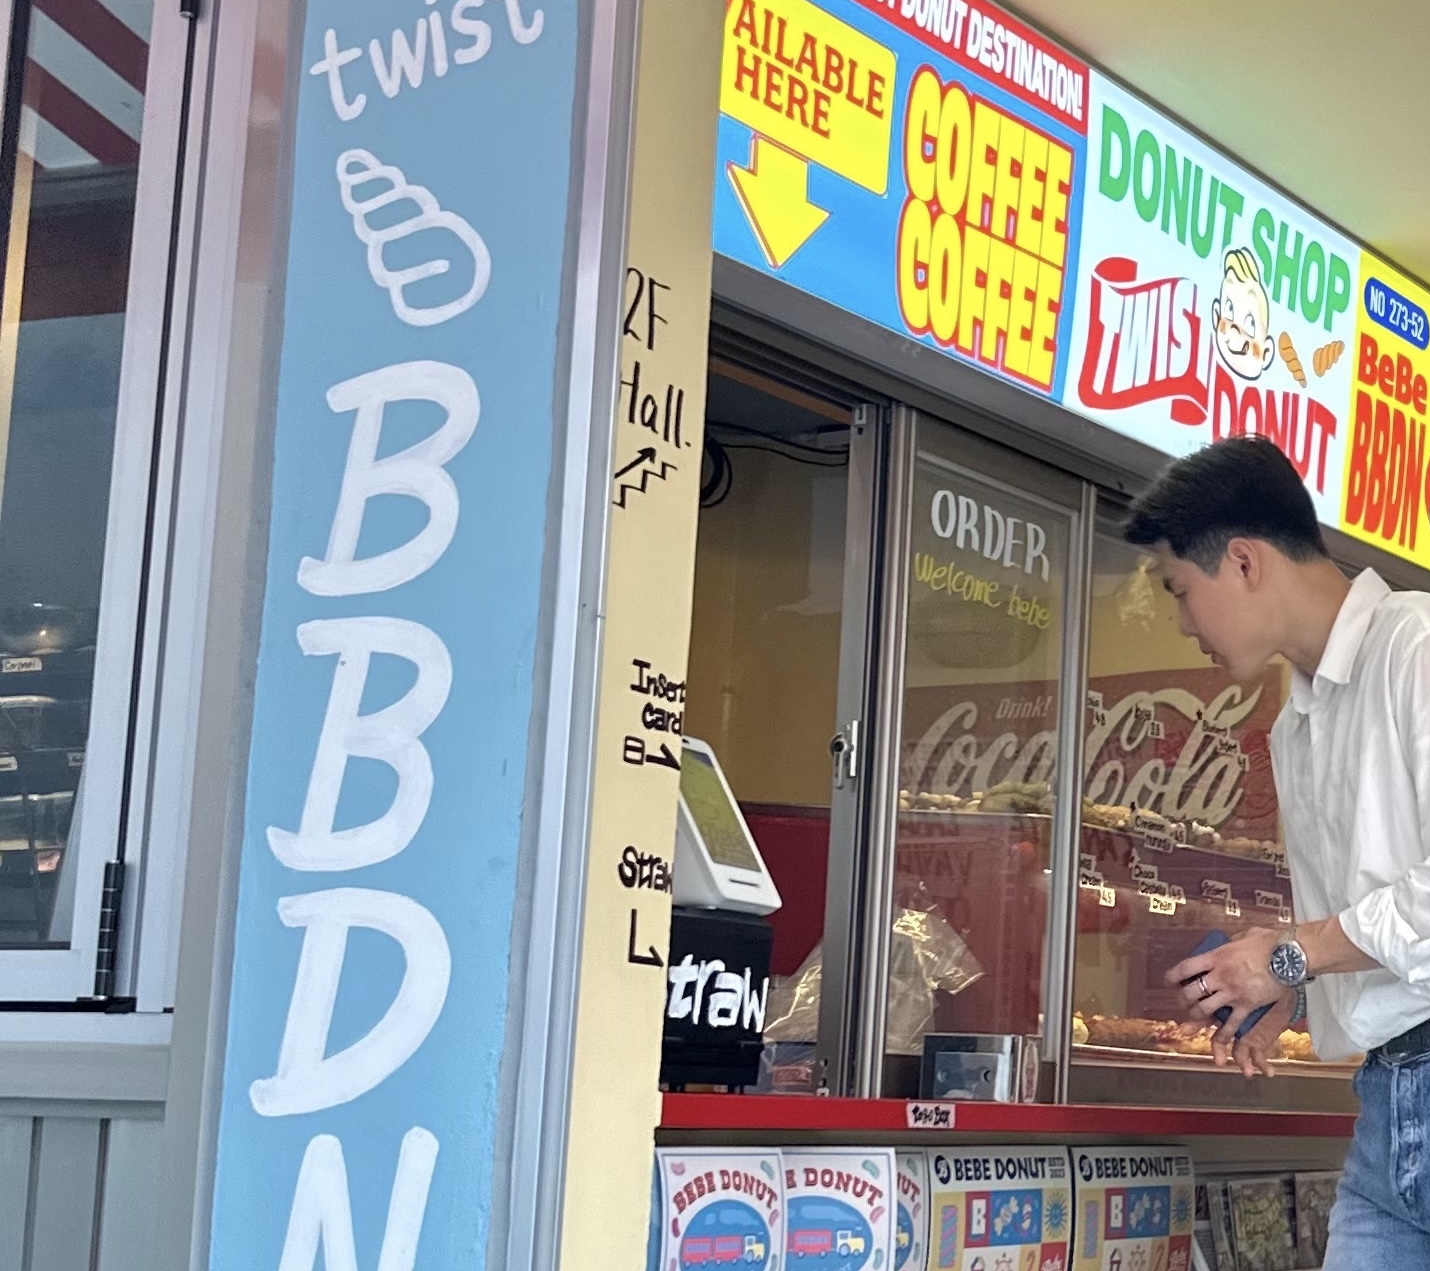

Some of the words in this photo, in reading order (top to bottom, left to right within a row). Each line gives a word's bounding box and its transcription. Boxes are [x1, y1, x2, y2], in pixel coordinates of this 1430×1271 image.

[734, 44, 832, 140] HERE
[966, 9, 1084, 121] DESTINATION!
[905, 68, 1073, 268] COFFEE
[1099, 103, 1245, 260] DONUT
[1252, 207, 1351, 333] SHOP
[624, 267, 672, 350] 2F
[898, 196, 1064, 388] COFFEE
[1388, 295, 1426, 341] 273-52
[1090, 271, 1212, 417] TWIST
[1357, 331, 1428, 416] BeBe
[1212, 364, 1338, 496] DONUT
[1344, 389, 1427, 551] BBDN
[931, 489, 1049, 583] ORDER
[1007, 584, 1051, 629] bebe
[996, 696, 1053, 720] Drink!
[672, 1170, 717, 1215] BEBE
[719, 1168, 778, 1209] DONUT
[803, 1167, 884, 1207] DONUT
[953, 1158, 992, 1182] BEBE
[995, 1156, 1047, 1180] DONUT
[1094, 1157, 1128, 1179] BEBE
[1130, 1156, 1174, 1178] DONUT
